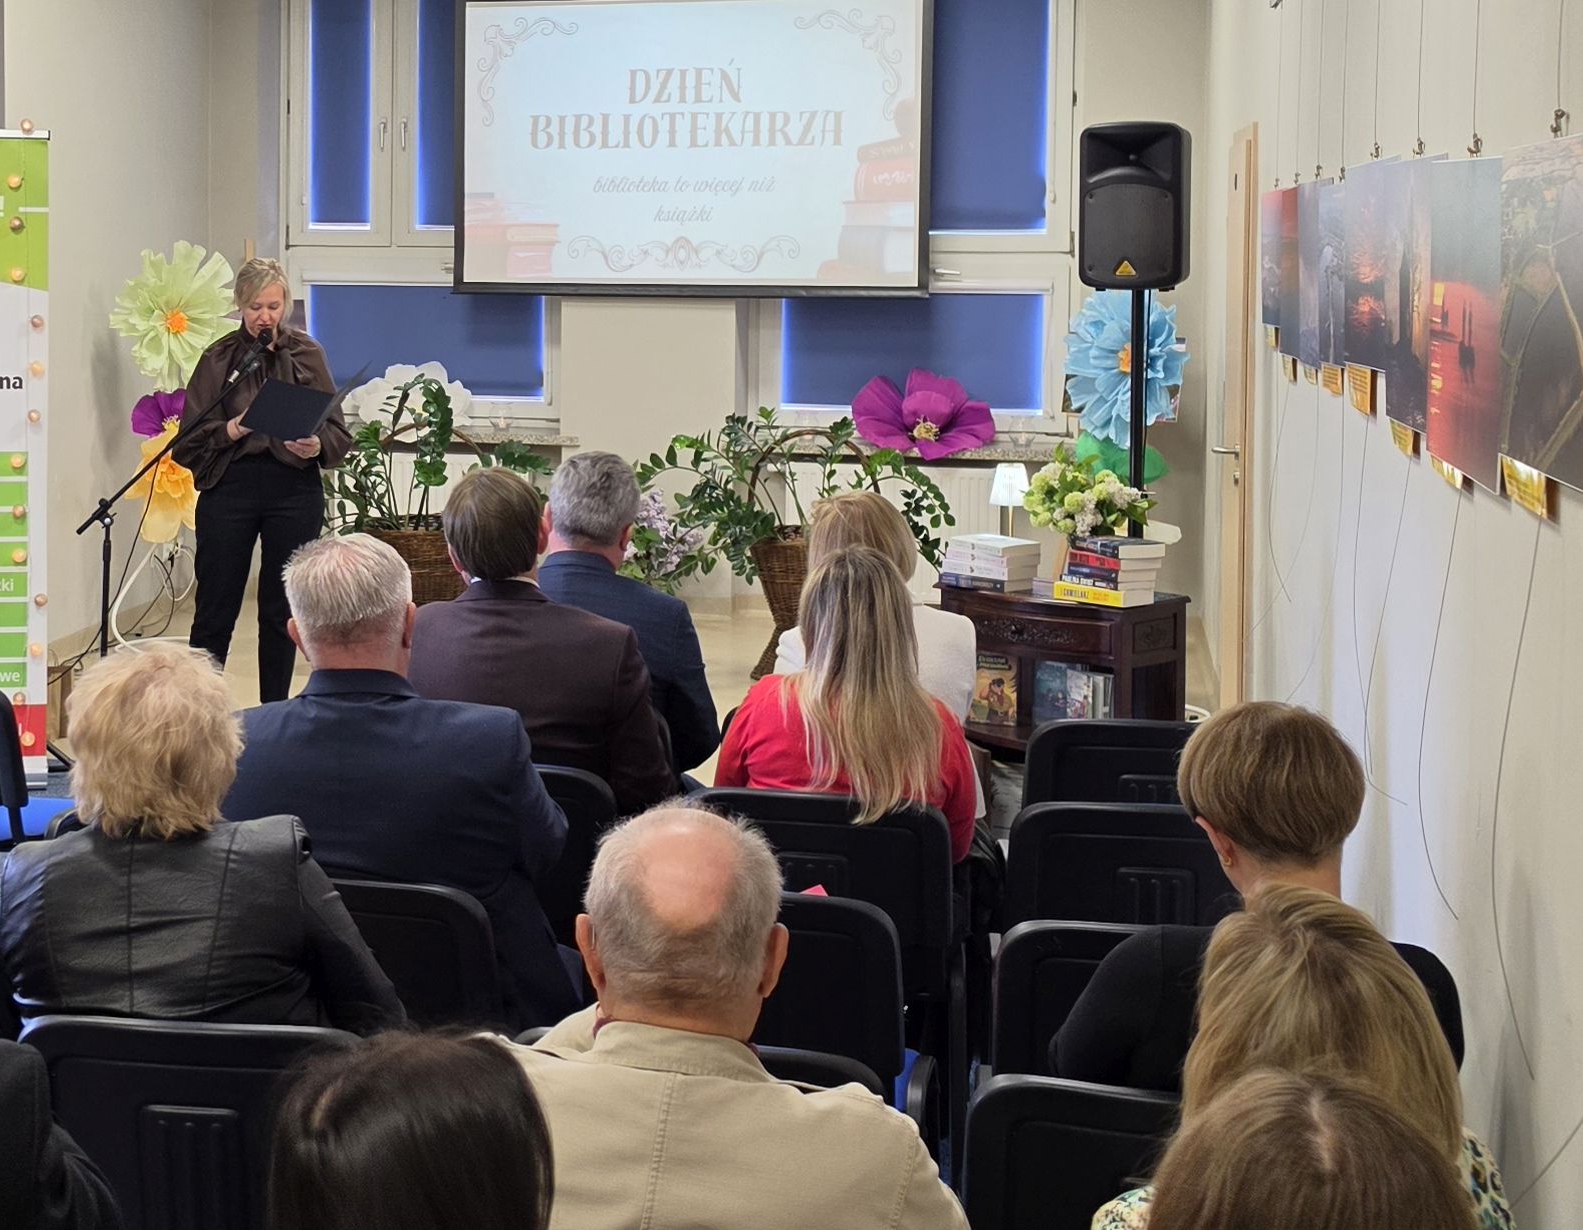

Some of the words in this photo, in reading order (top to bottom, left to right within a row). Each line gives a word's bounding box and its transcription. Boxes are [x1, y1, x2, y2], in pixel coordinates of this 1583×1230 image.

[627, 57, 743, 105] DZIEŃ
[529, 110, 844, 150] BIBLIOTEKARZA
[593, 175, 669, 193] biblioteka
[673, 176, 692, 193] to
[693, 176, 745, 197] więcej
[747, 176, 776, 193] niż
[653, 203, 714, 226] książki
